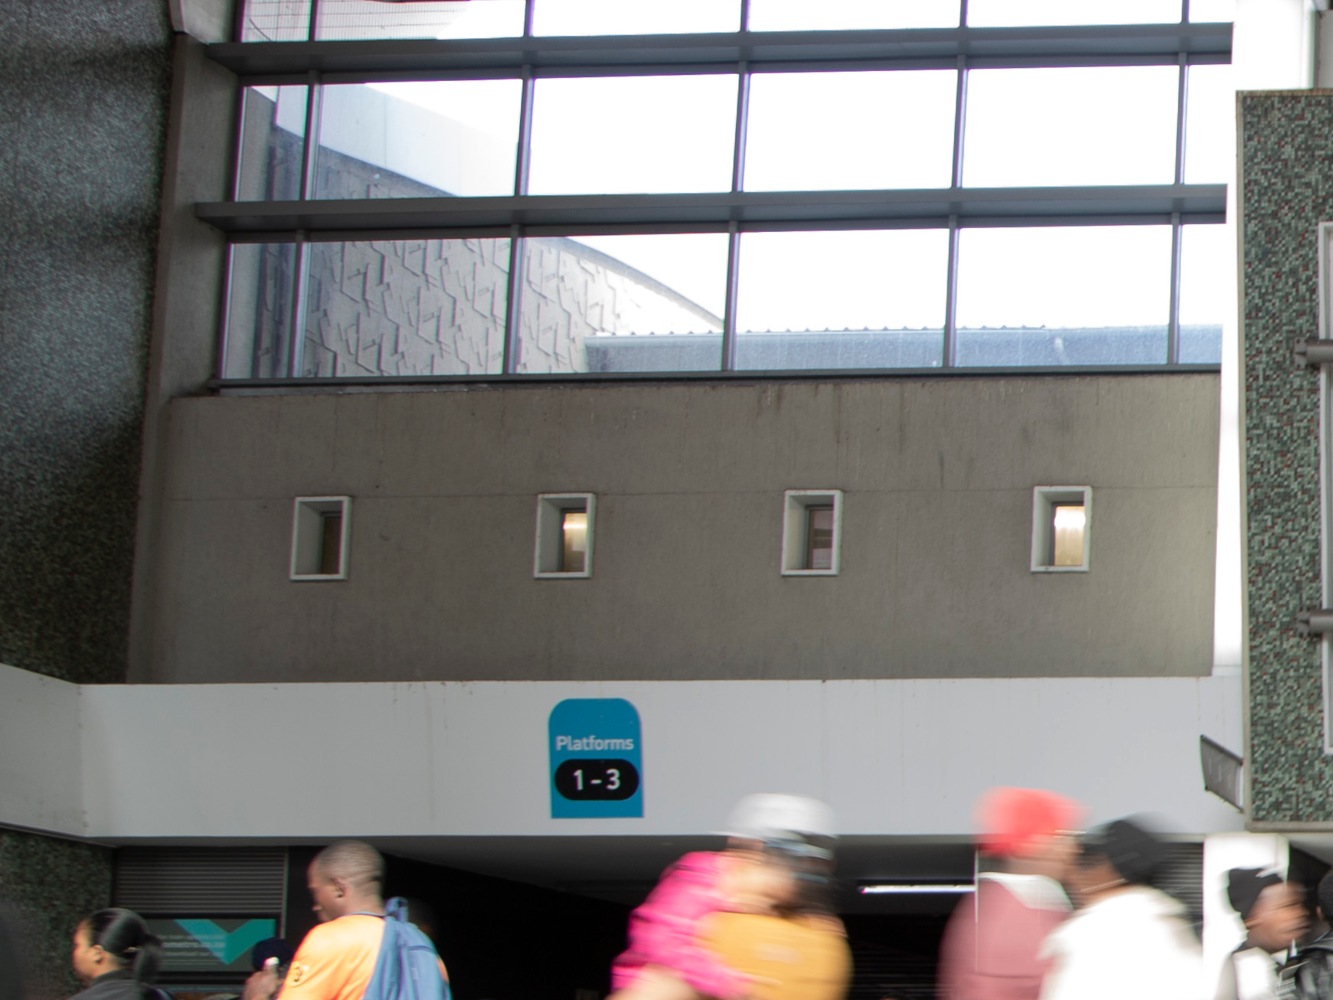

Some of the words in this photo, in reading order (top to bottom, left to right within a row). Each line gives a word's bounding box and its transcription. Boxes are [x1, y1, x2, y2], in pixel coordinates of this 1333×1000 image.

[556, 735, 634, 750] Platforms
[573, 769, 583, 790] 1
[606, 768, 621, 790] 3
